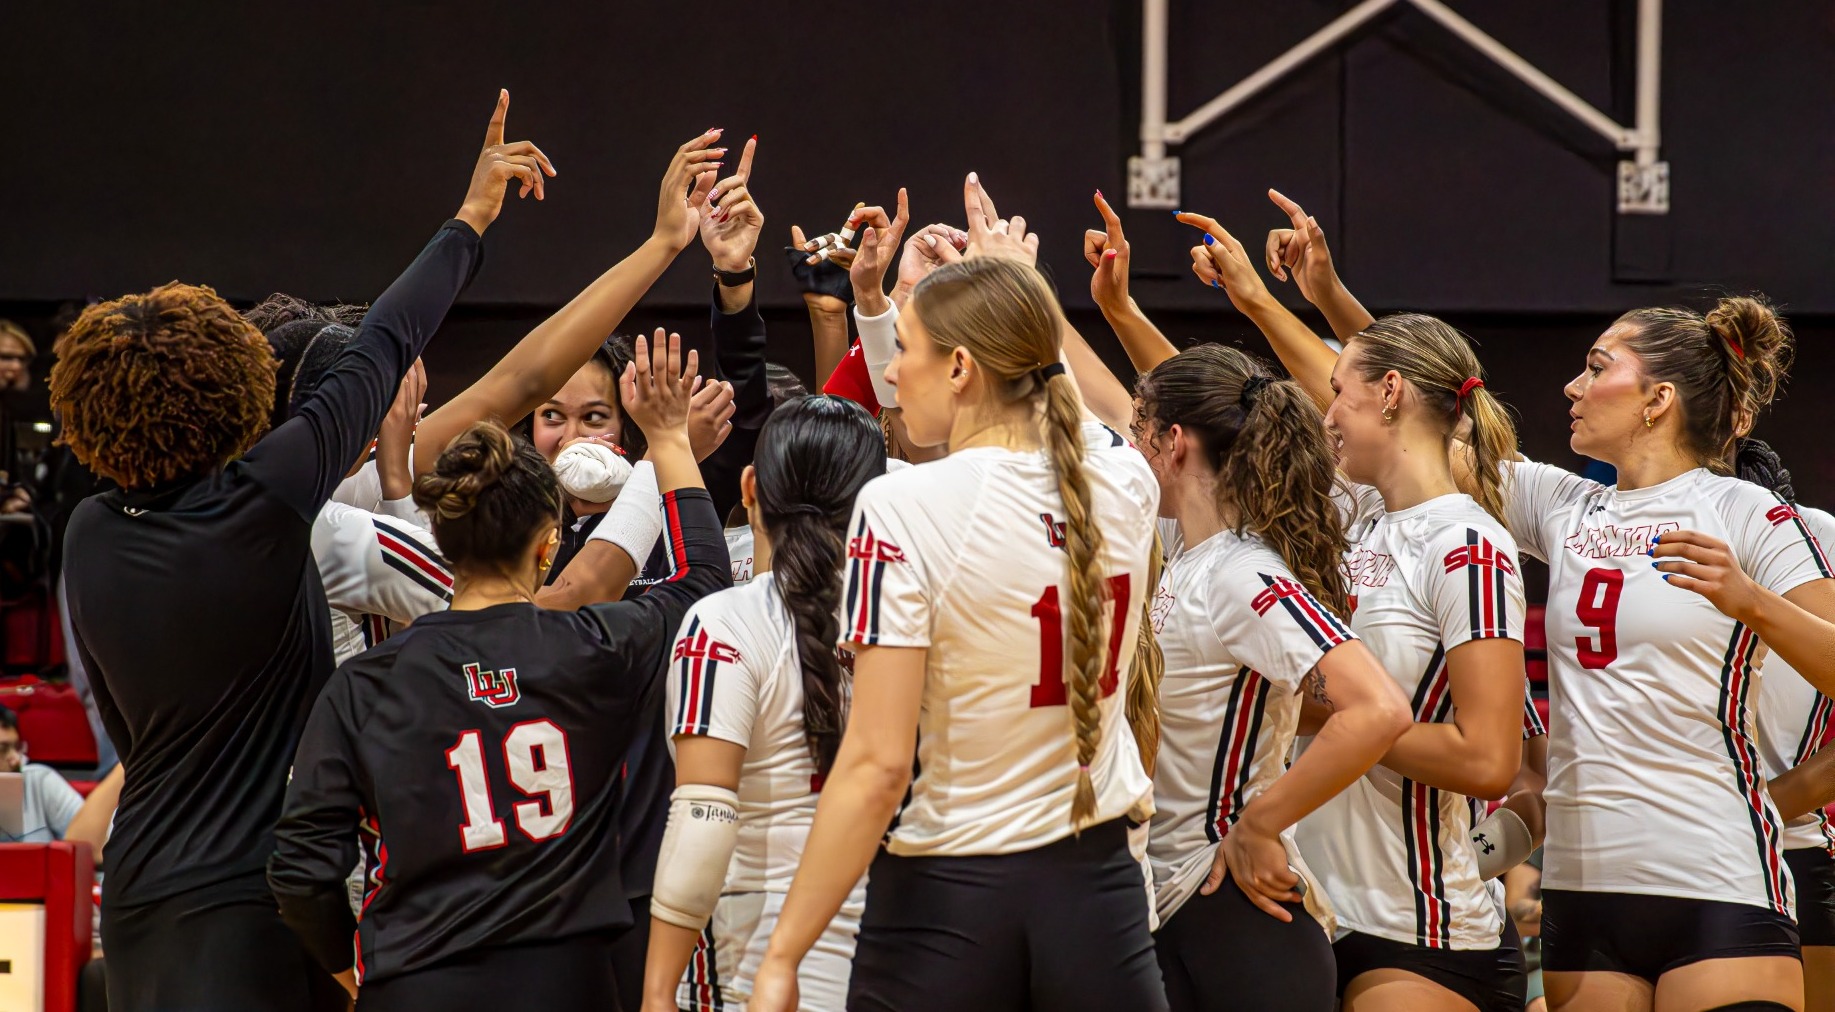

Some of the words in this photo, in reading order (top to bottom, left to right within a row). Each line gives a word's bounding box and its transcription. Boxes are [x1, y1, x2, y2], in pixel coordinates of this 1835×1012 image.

[1443, 543, 1518, 577] SLC
[1250, 578, 1304, 619] SL
[1574, 567, 1625, 670] 9
[462, 662, 522, 709] LU
[444, 717, 576, 854] 19
